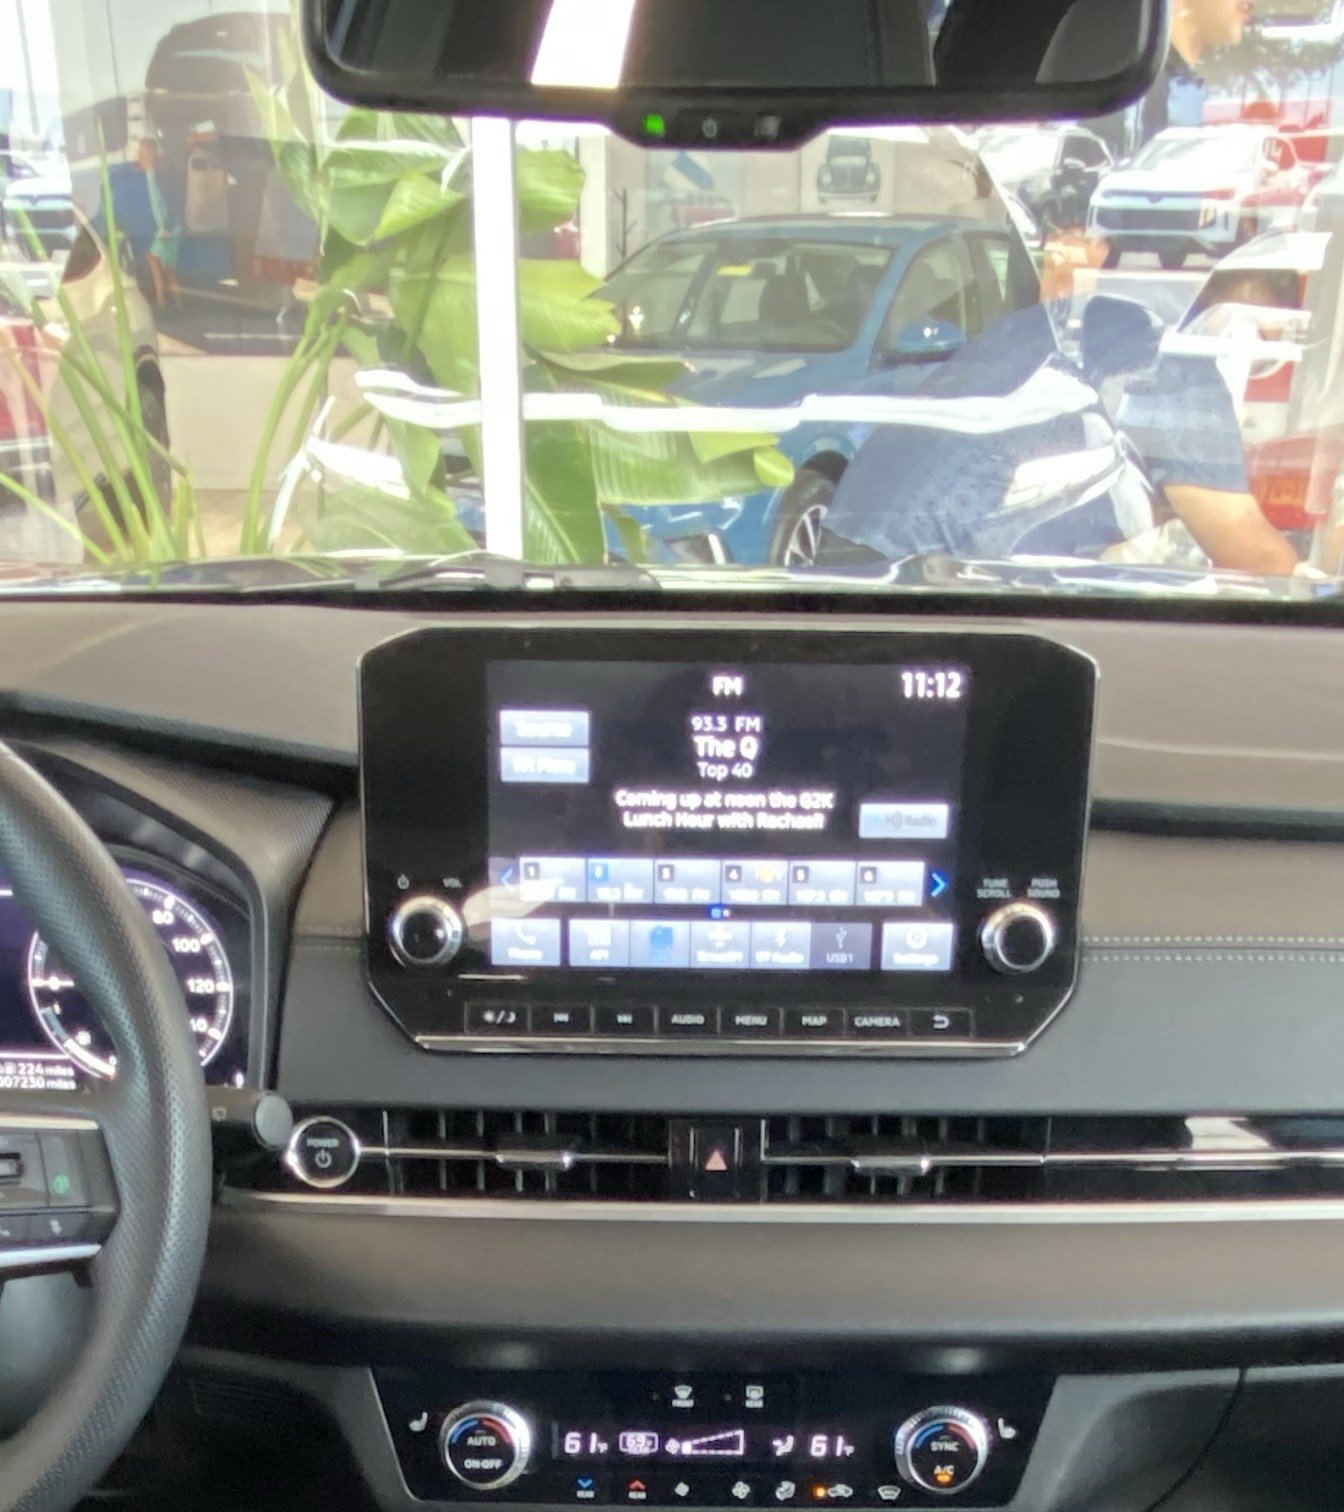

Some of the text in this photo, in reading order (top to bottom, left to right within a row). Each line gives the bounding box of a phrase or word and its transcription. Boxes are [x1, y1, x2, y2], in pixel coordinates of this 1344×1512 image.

[712, 676, 744, 696] FM
[902, 671, 962, 699] 11:12
[691, 716, 761, 732] 93.3 FM
[694, 736, 758, 760] The Q
[697, 762, 754, 781] Top 40
[615, 789, 677, 810] Coming
[679, 793, 702, 810] up
[704, 791, 722, 808] at
[768, 791, 798, 809] the
[623, 811, 673, 828] Lunch
[676, 812, 714, 828] Hour
[717, 812, 755, 829] with
[172, 938, 201, 953] 100
[186, 979, 215, 994] 120
[671, 1014, 705, 1026] AUDIO
[735, 1014, 768, 1027] MENU
[801, 1015, 827, 1027] MAP
[854, 1016, 901, 1028] CAMERA
[17, 1063, 45, 1075] 224
[467, 1436, 497, 1446] AUTO
[930, 1441, 960, 1451] SYNC
[933, 1464, 955, 1475] A/C
